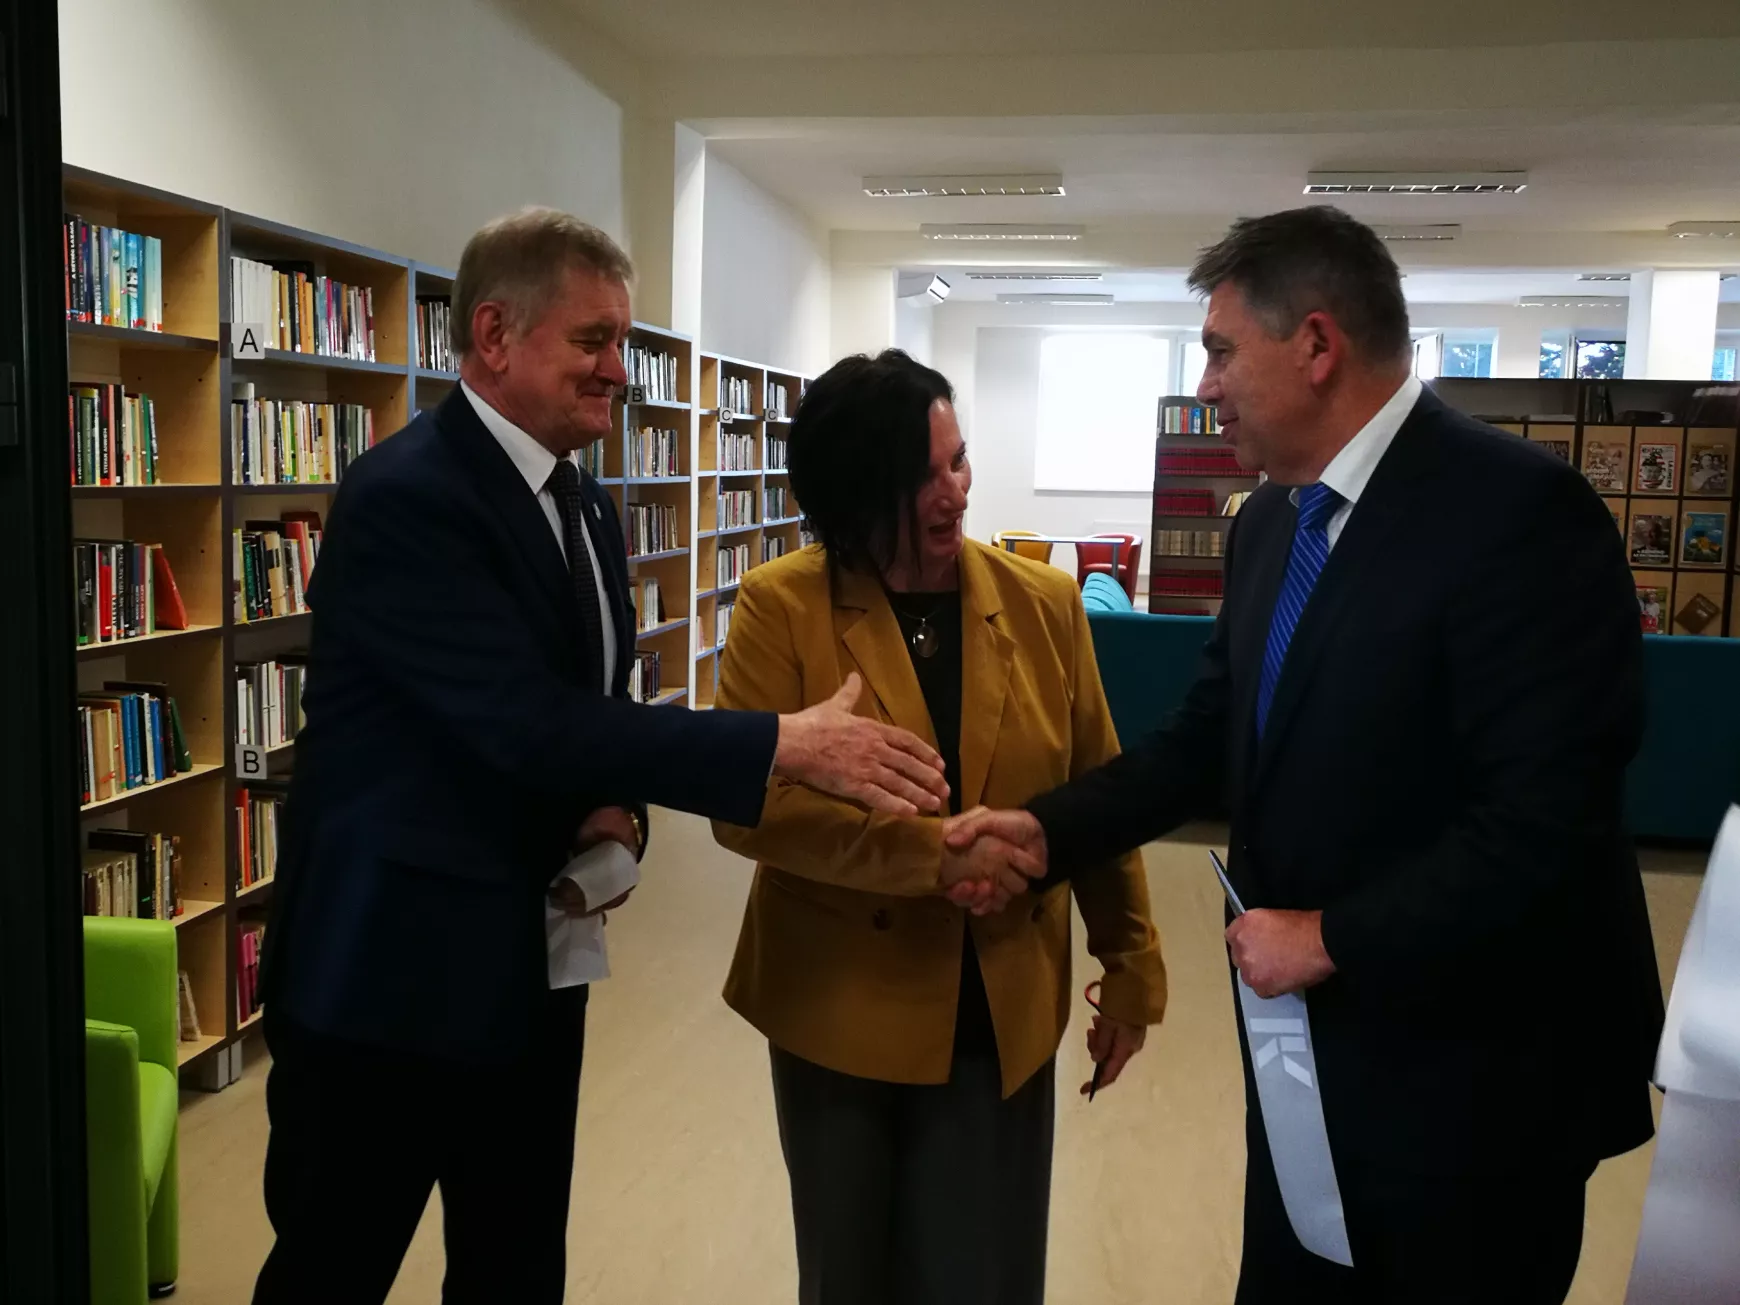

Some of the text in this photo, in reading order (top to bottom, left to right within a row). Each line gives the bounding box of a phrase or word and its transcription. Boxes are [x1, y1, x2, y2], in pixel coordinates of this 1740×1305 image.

[239, 328, 259, 353] A
[632, 387, 643, 402] B
[721, 409, 731, 421] C
[767, 409, 777, 421] C
[243, 749, 260, 774] B
